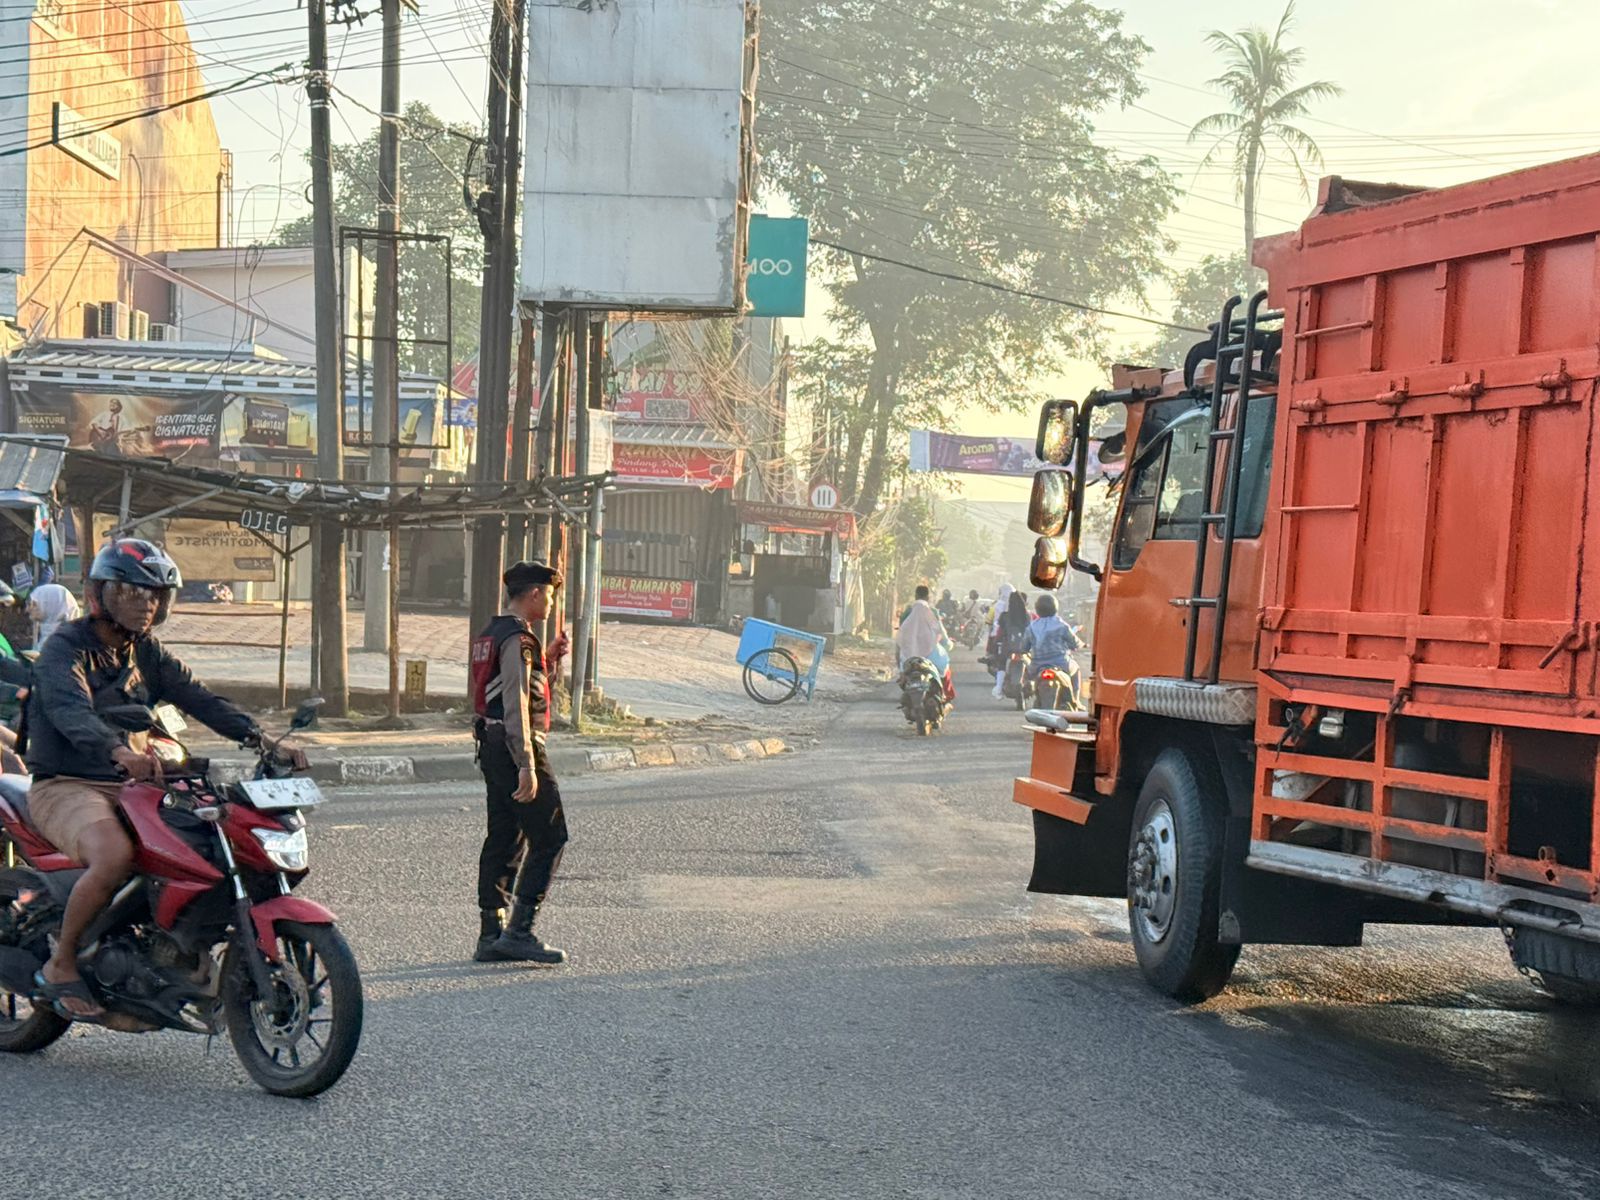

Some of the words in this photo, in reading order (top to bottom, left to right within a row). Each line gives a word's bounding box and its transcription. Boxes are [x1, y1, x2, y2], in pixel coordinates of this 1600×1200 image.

[18, 416, 66, 424] SIGNATURE
[959, 443, 995, 457] Aroma
[241, 509, 288, 534] OJEG
[629, 578, 668, 593] RAMPAI
